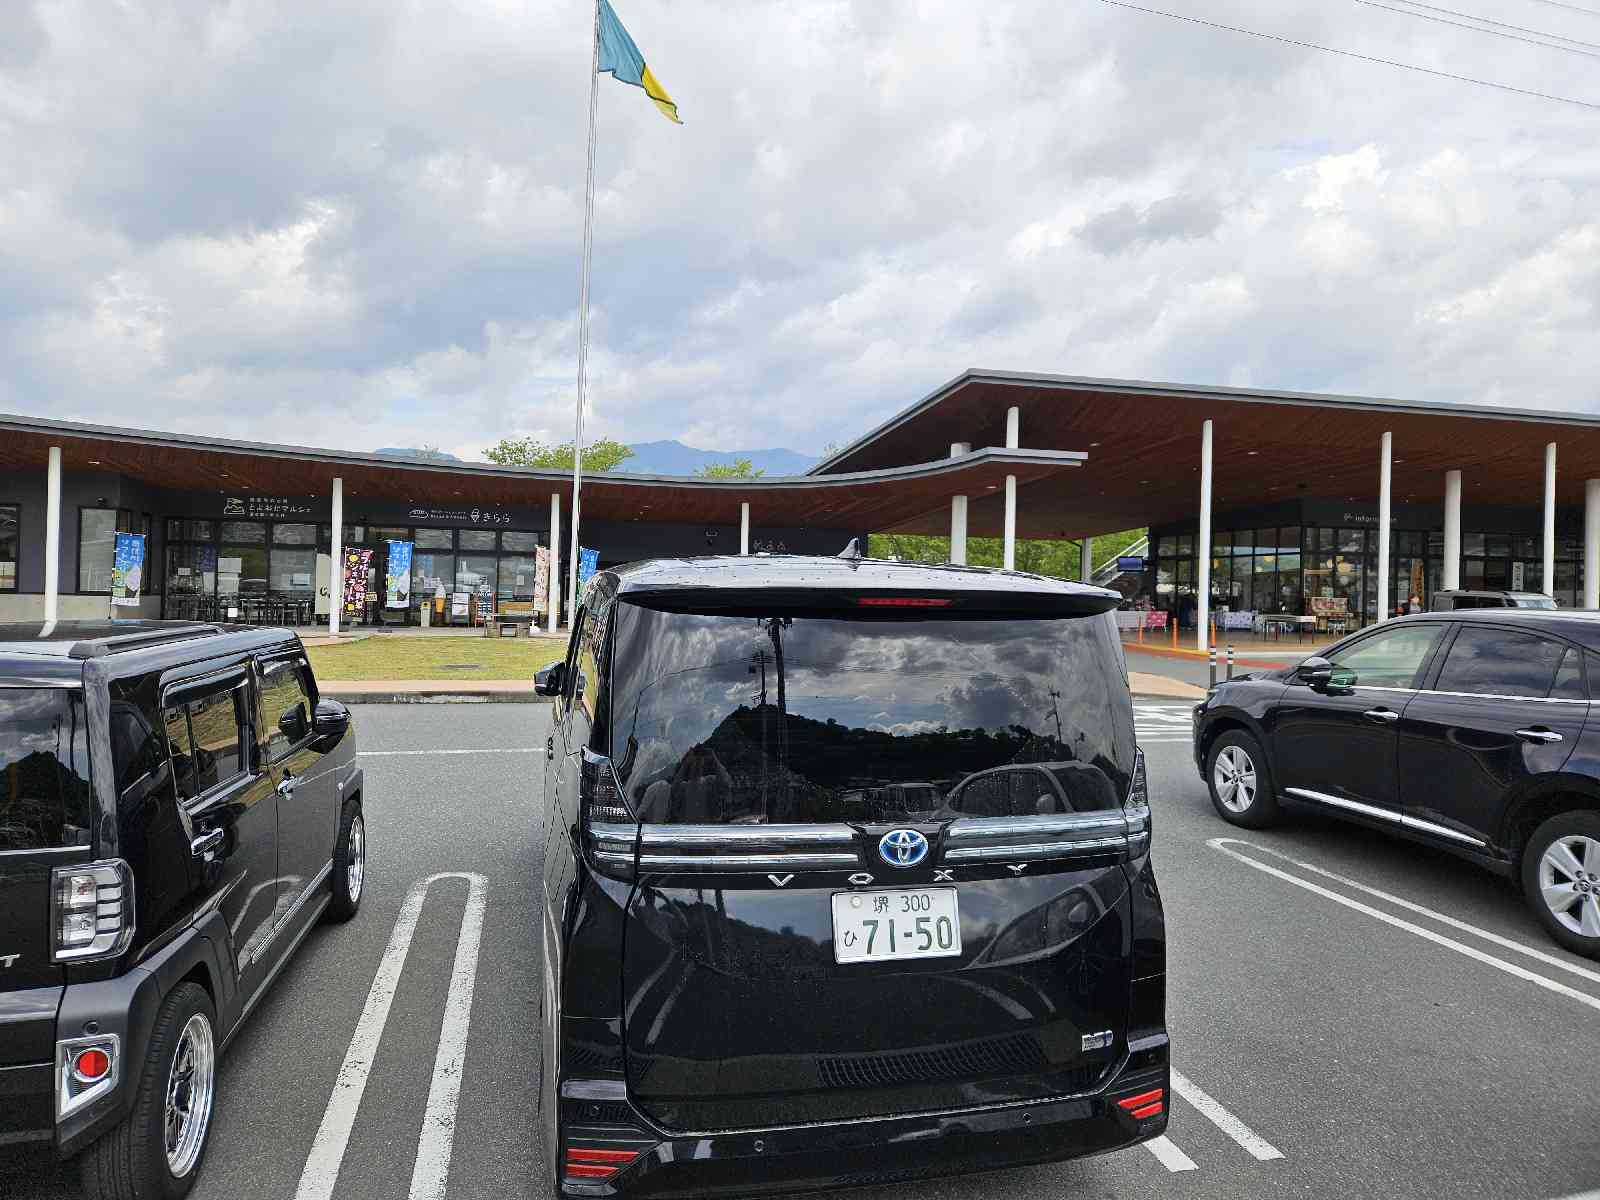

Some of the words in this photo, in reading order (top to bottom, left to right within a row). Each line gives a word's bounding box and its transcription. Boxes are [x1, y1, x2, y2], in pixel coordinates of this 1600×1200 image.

[249, 503, 312, 513] とよおかマルシェ
[483, 512, 511, 523] きらら
[767, 863, 1028, 888] VOXY
[872, 896, 889, 914] 堺
[900, 894, 931, 913] 300
[843, 930, 858, 948] ひ
[862, 915, 953, 955] 71-50
